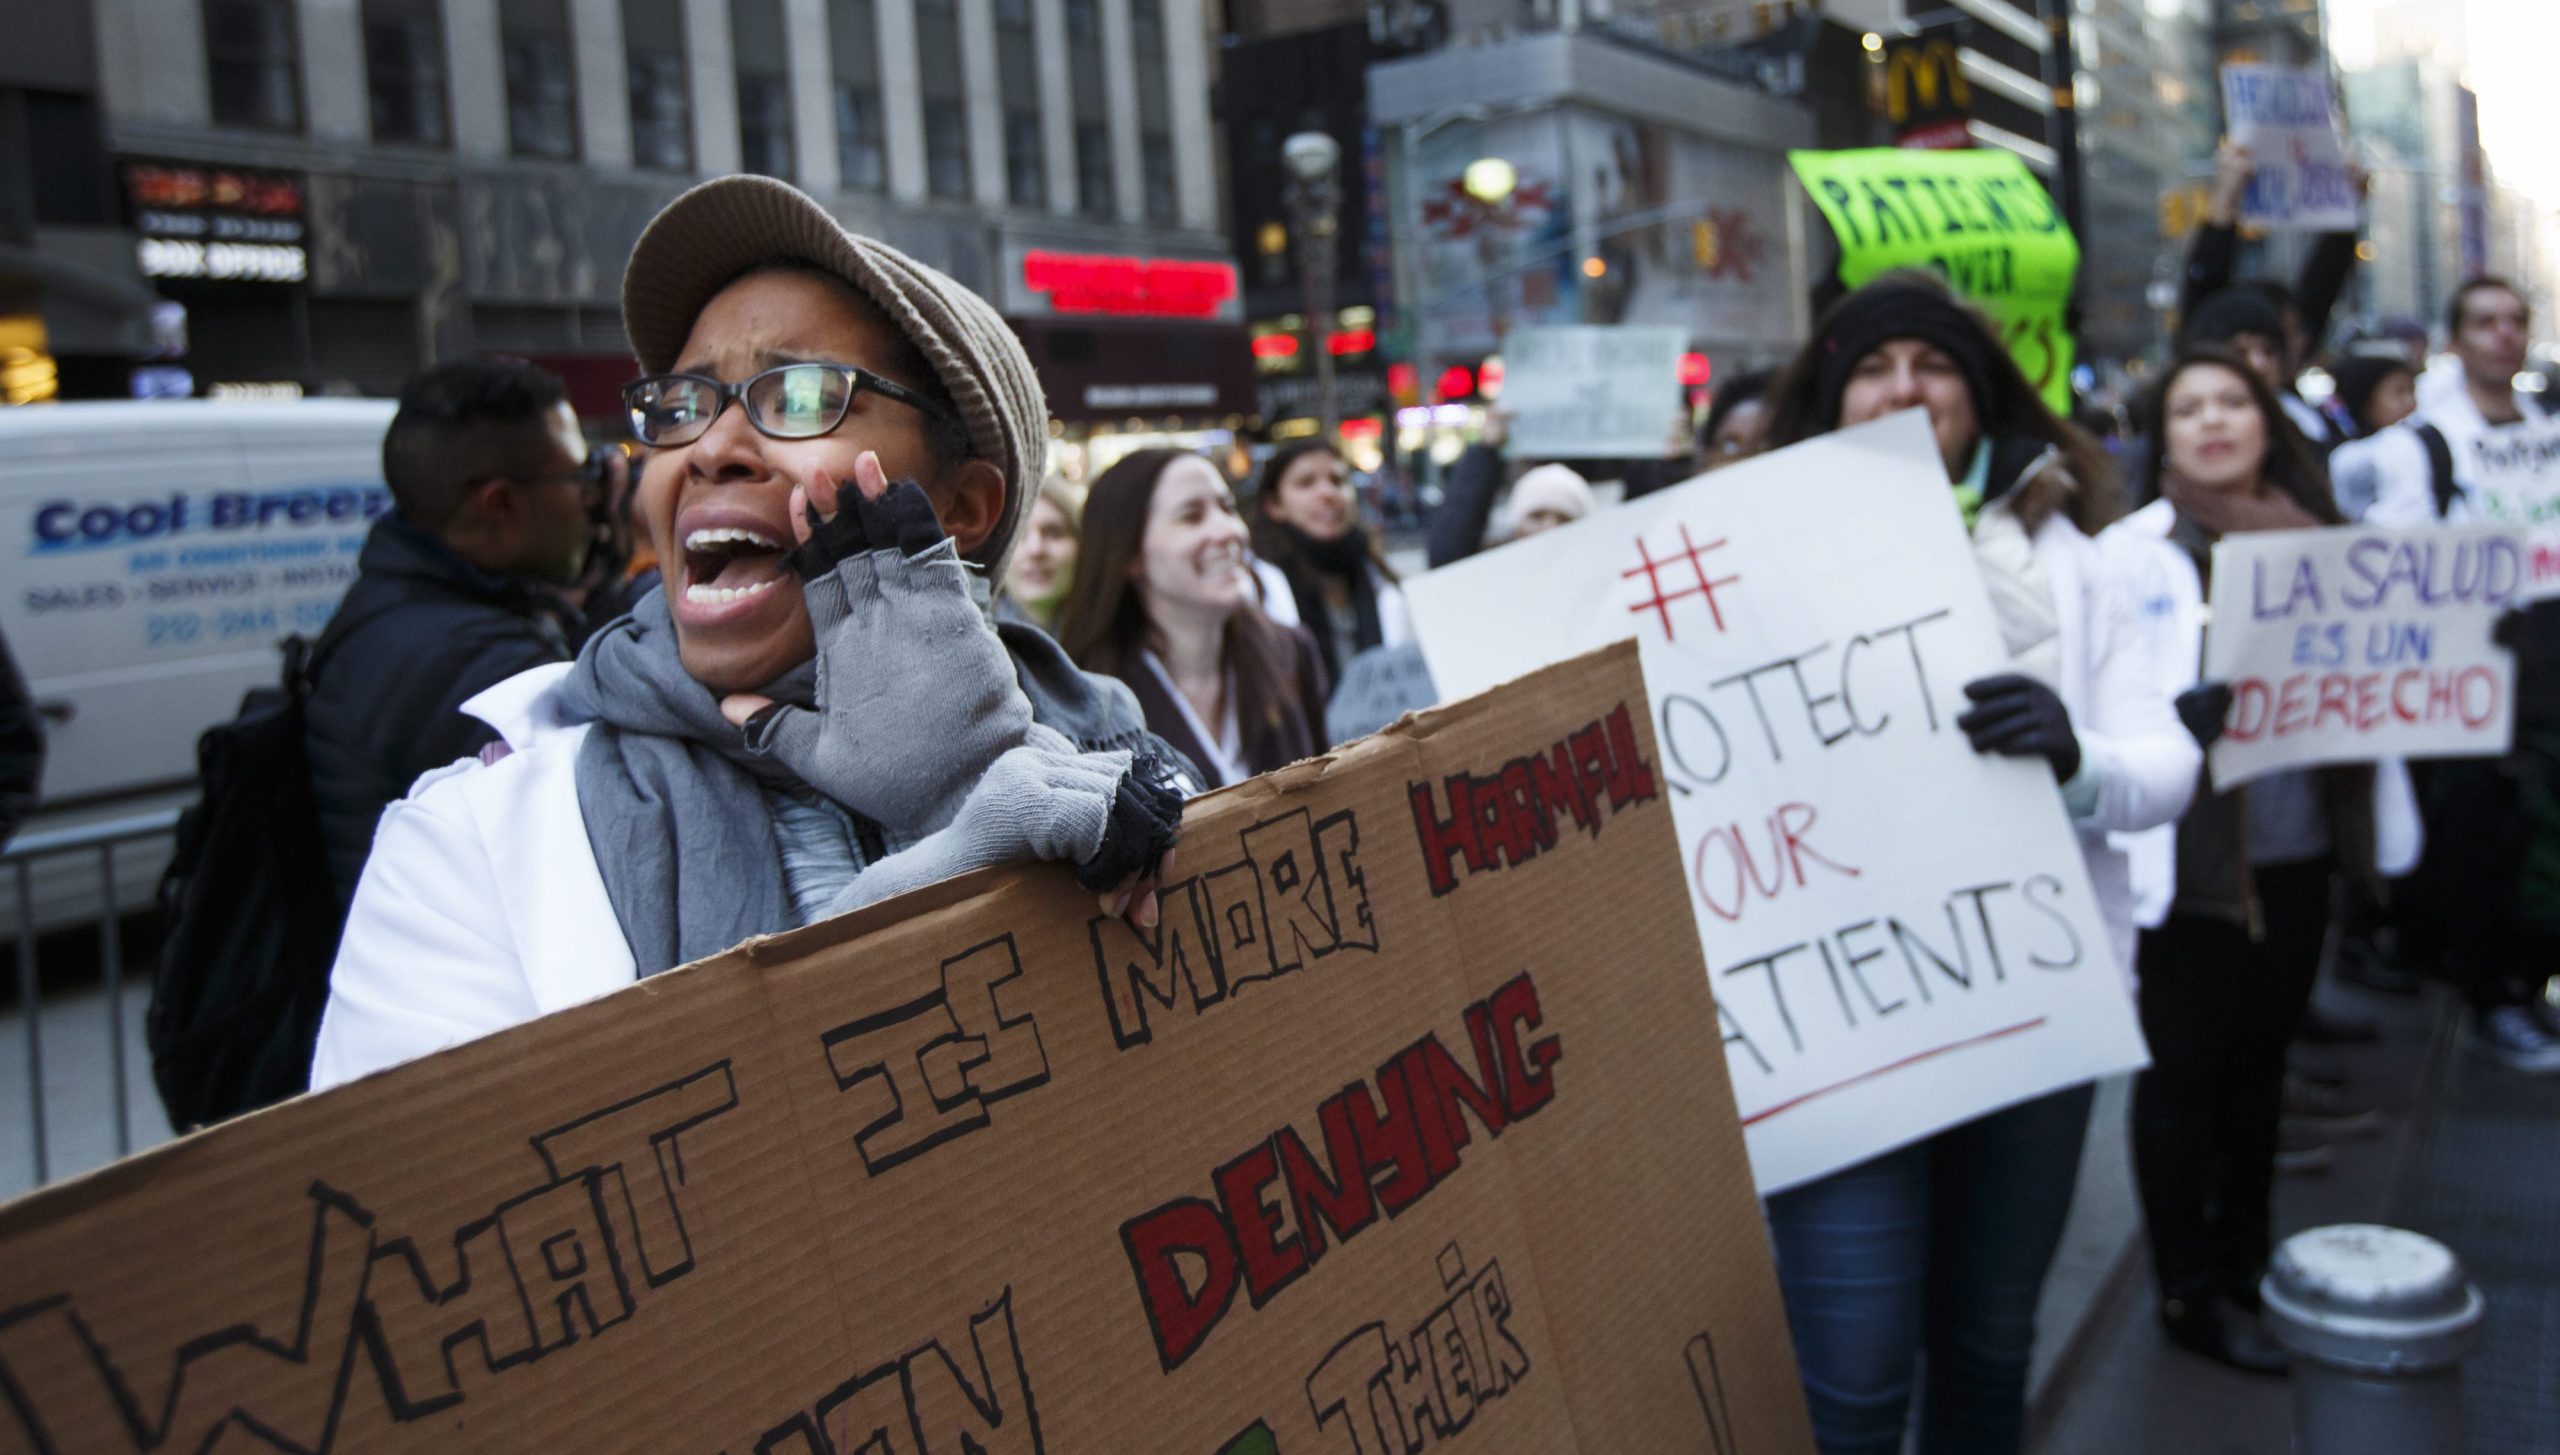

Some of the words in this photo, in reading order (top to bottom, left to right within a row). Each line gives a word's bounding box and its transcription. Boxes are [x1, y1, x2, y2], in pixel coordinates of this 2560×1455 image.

[1821, 175, 2058, 247] PATIENTS
[34, 491, 190, 541] Cool
[209, 488, 395, 530] Breez
[25, 584, 125, 614] SALES
[147, 573, 258, 602] SERVICE
[282, 563, 360, 587] INSTA
[2251, 555, 2326, 622] LA
[2340, 536, 2521, 610] SALUD
[2292, 622, 2348, 667] ES
[2365, 623, 2431, 665] UN
[1665, 609, 1950, 797] OTECT
[2222, 665, 2500, 743] DERECHO
[1694, 803, 1861, 921] OUR
[1712, 873, 2083, 1074] ATIENTS
[0, 1060, 739, 1455] WHAT
[1088, 806, 1379, 1051] MORE
[1408, 701, 1658, 898] HARMFUL
[1118, 971, 1563, 1374] DENYING
[1305, 1240, 1531, 1455] THEIR
